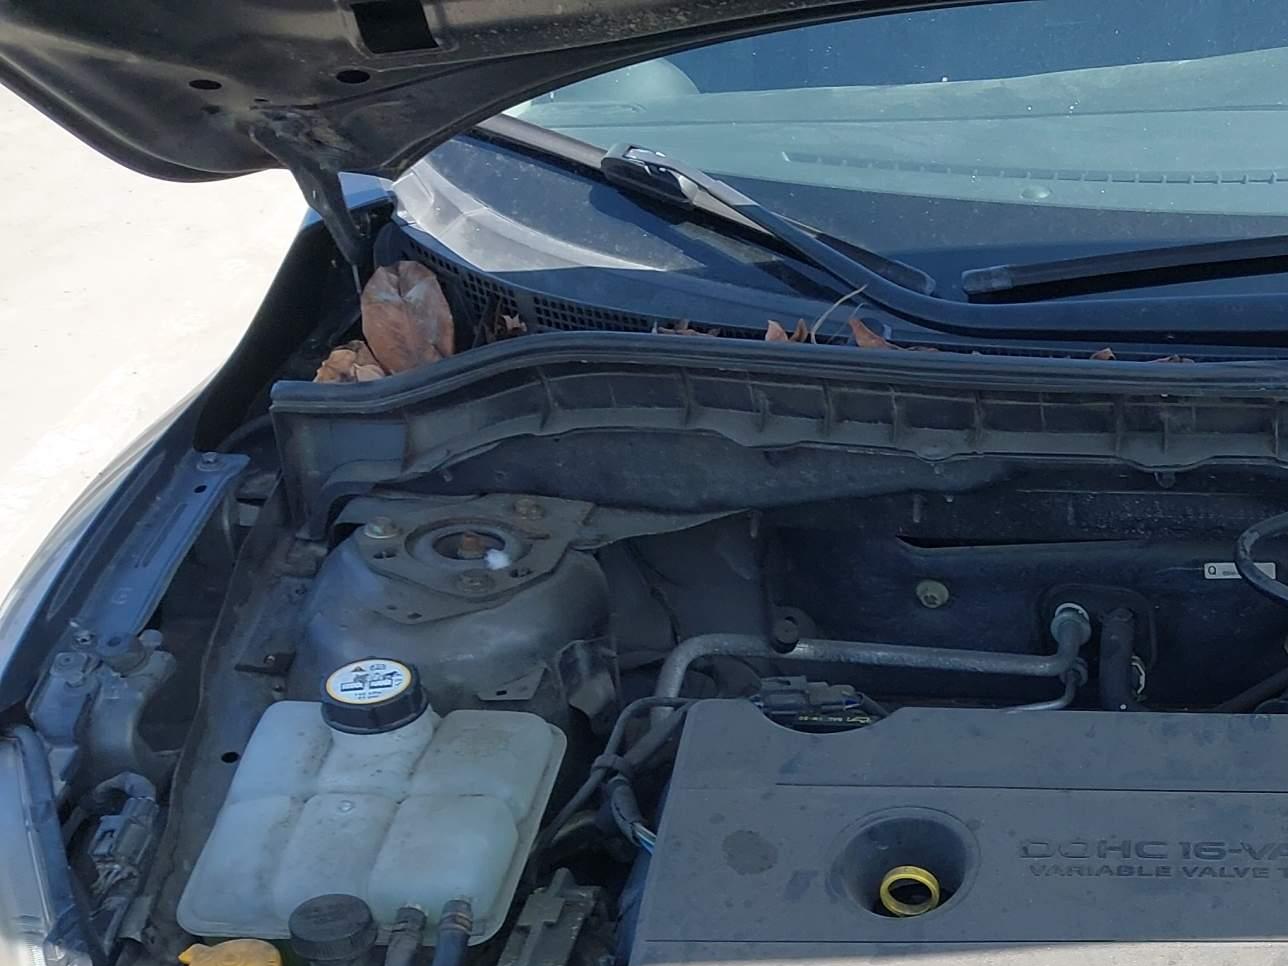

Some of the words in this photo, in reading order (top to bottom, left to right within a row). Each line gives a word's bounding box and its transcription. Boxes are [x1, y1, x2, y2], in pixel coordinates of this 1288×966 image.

[1019, 840, 1169, 859] DOHC
[1029, 864, 1172, 877] VARIABLE
[1182, 866, 1270, 878] VALVE
